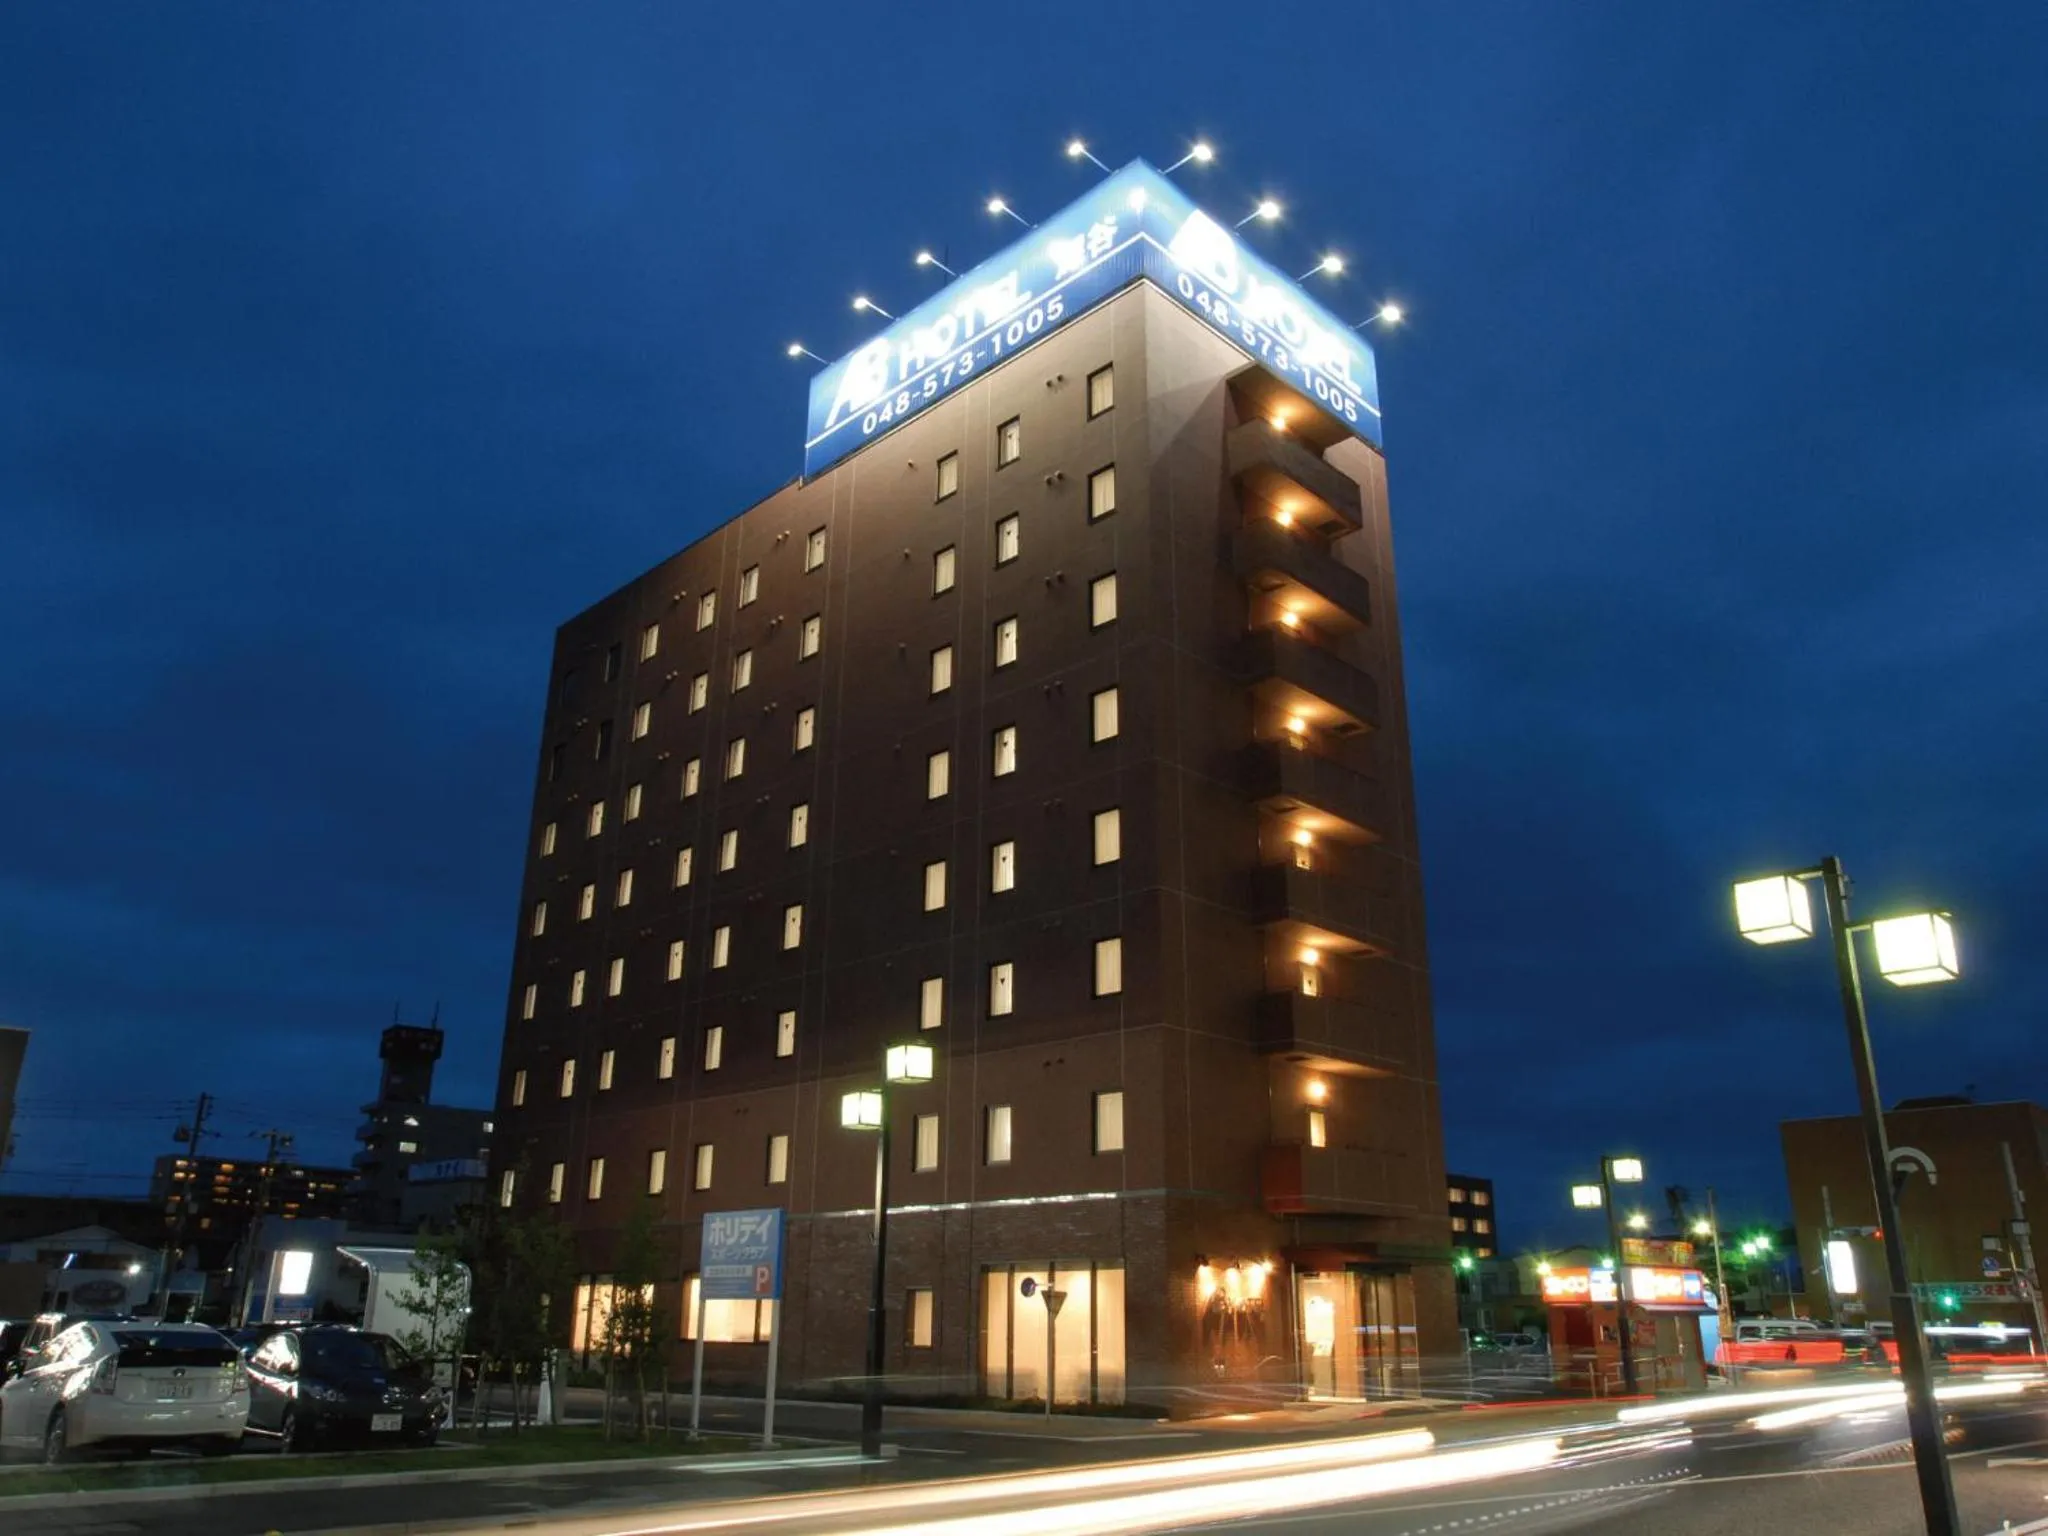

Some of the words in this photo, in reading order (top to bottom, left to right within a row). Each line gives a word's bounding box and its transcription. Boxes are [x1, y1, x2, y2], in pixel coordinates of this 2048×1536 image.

[862, 295, 1065, 435] 048-573-1005
[1178, 272, 1357, 422] 048-573-1005
[756, 1266, 770, 1293] P
